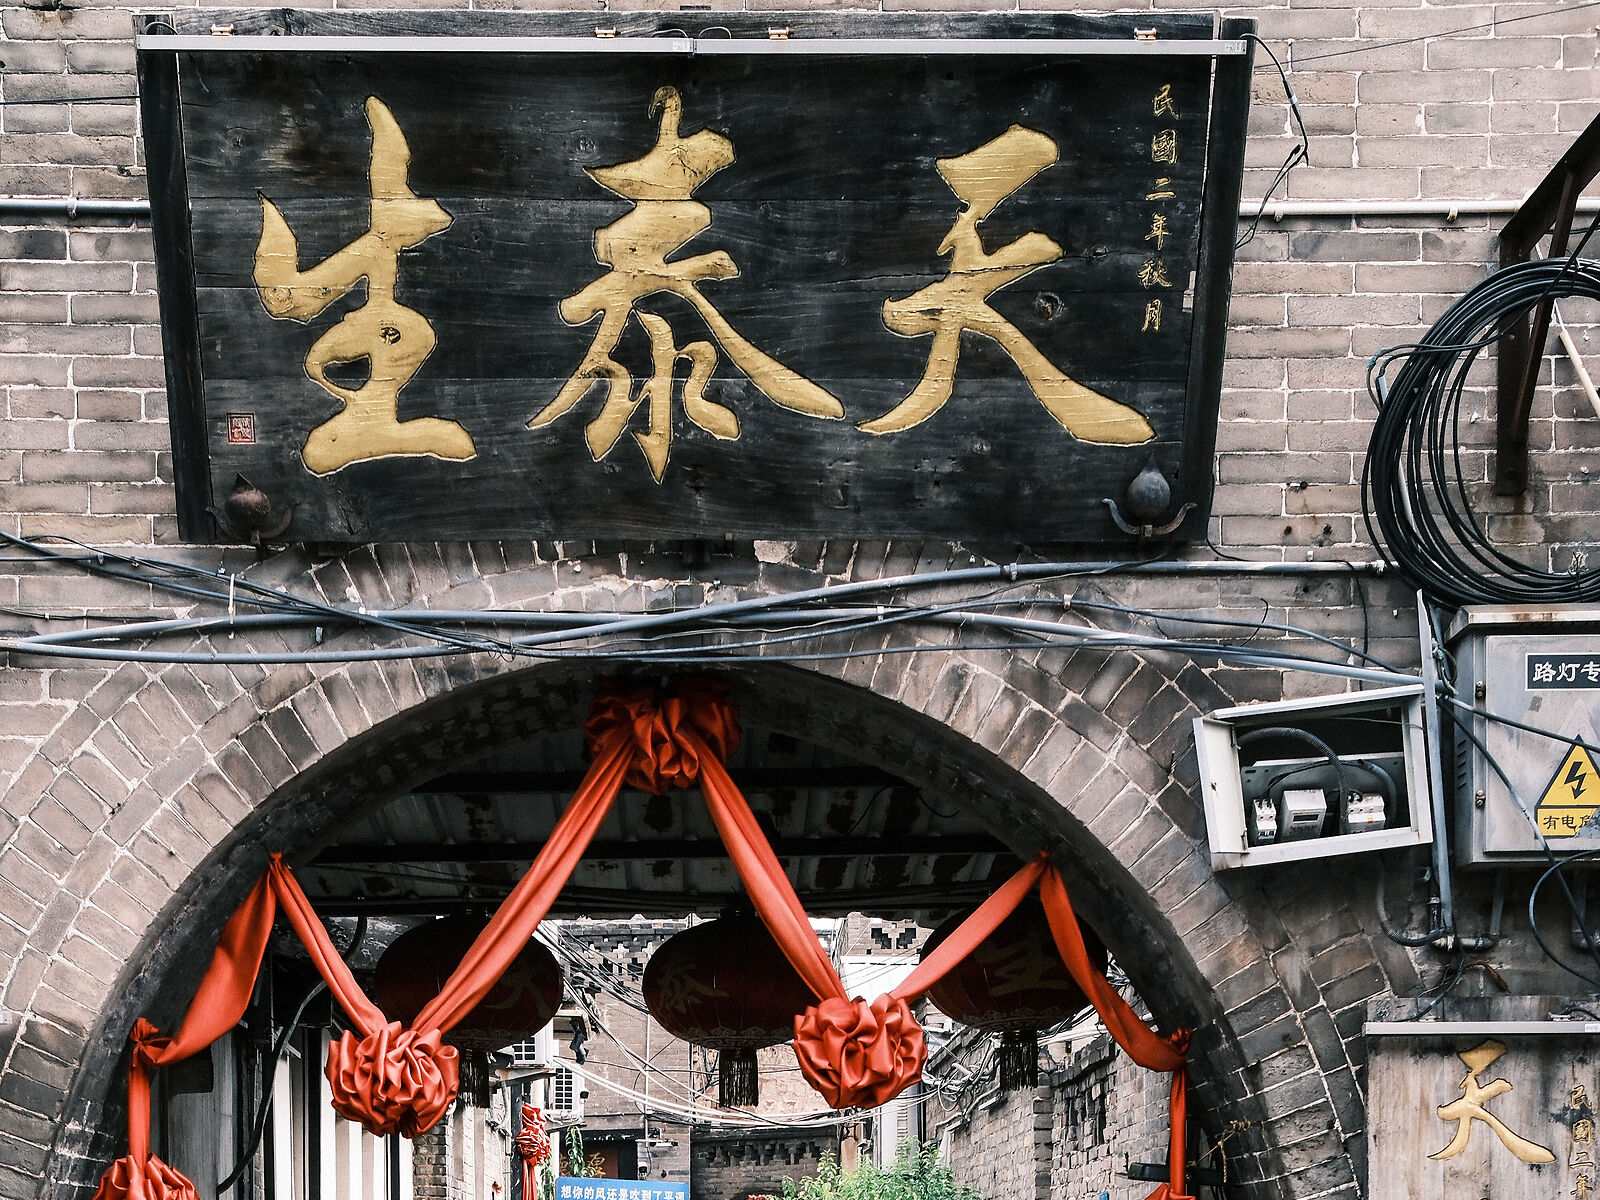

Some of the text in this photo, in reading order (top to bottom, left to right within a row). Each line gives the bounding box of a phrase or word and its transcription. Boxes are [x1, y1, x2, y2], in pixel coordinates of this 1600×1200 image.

[253, 84, 1159, 485] 天泰生
[1137, 82, 1180, 333] 民國二年秋月
[1532, 660, 1600, 683] 路灯专
